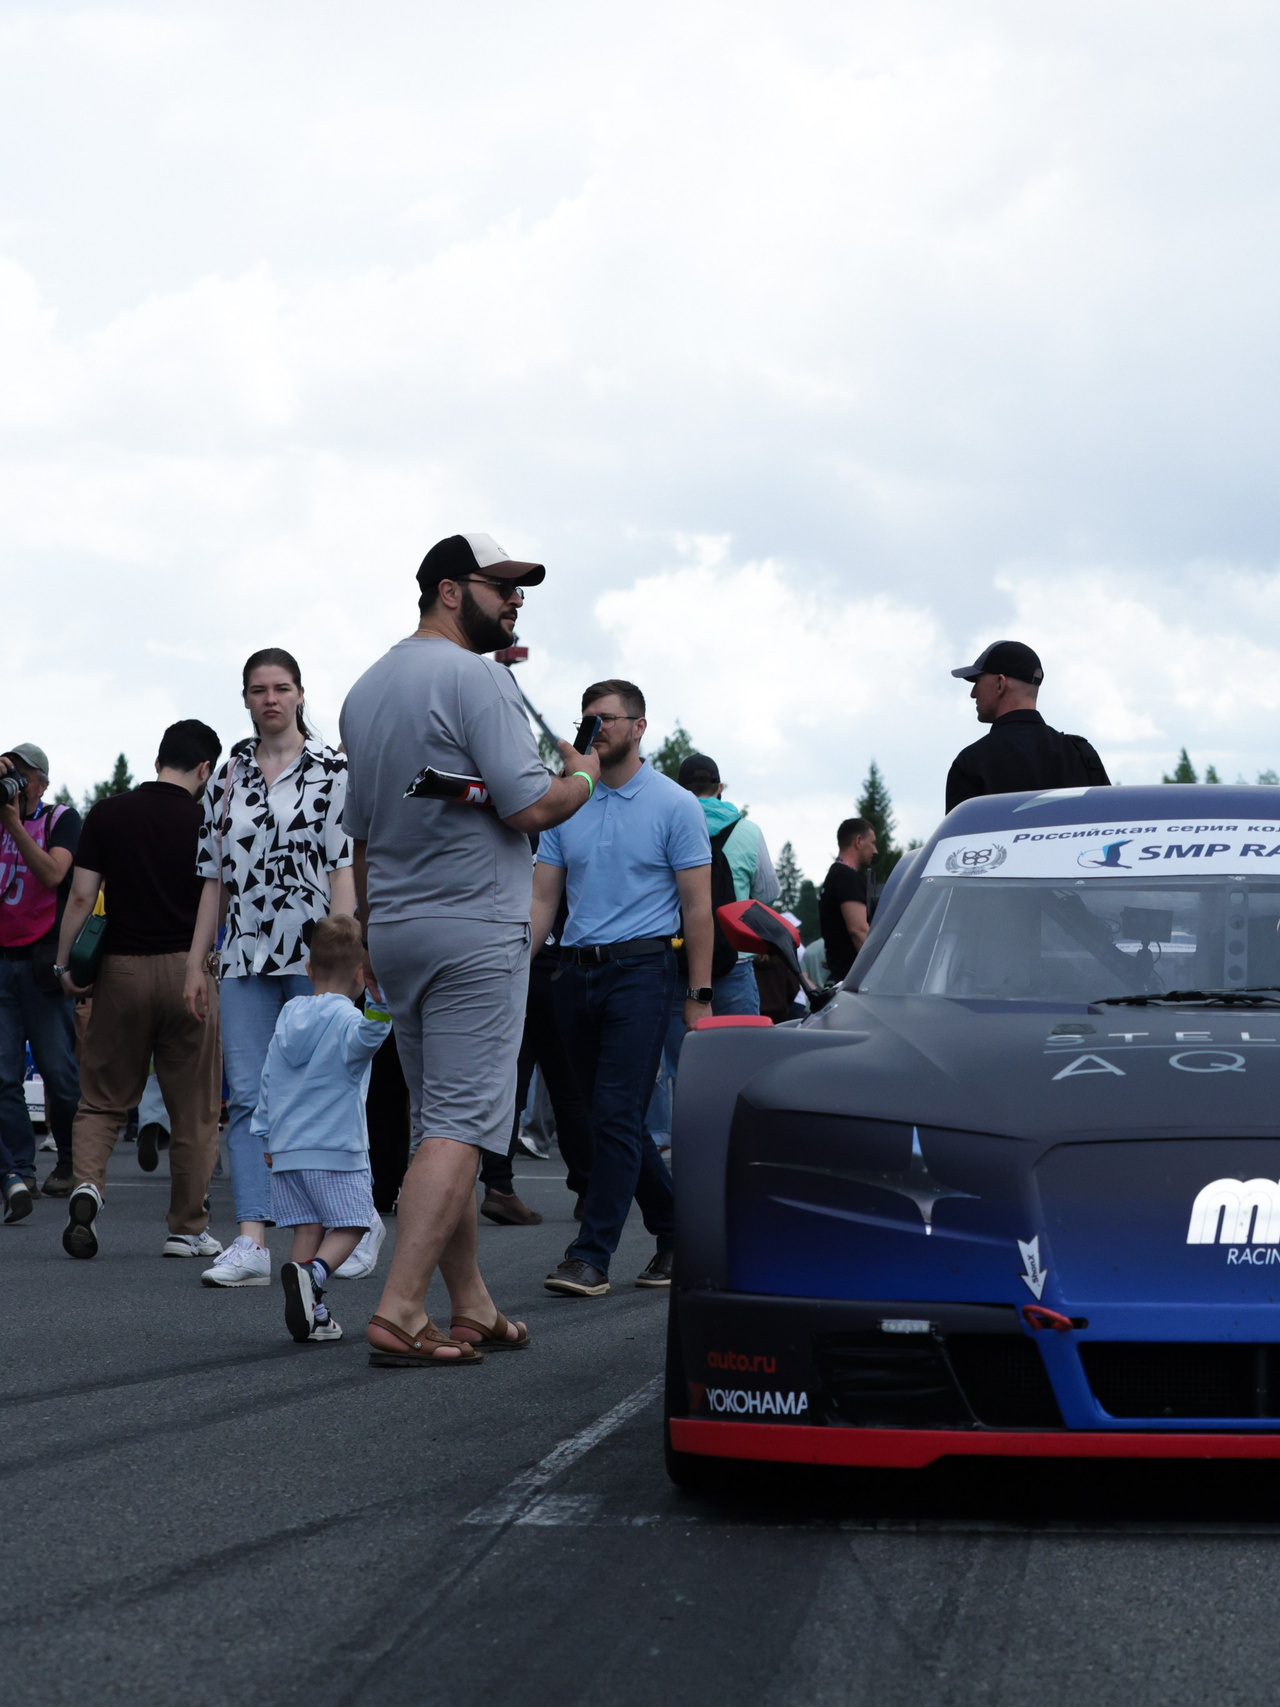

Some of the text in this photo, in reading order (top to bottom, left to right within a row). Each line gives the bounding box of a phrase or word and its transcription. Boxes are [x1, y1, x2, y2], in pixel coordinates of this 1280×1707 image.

[1012, 826, 1157, 844] Российская
[1166, 825, 1238, 834] серия
[1138, 843, 1231, 861] SMP
[707, 1350, 777, 1373] auto.ru
[706, 1388, 808, 1415] YOKOHAMA
